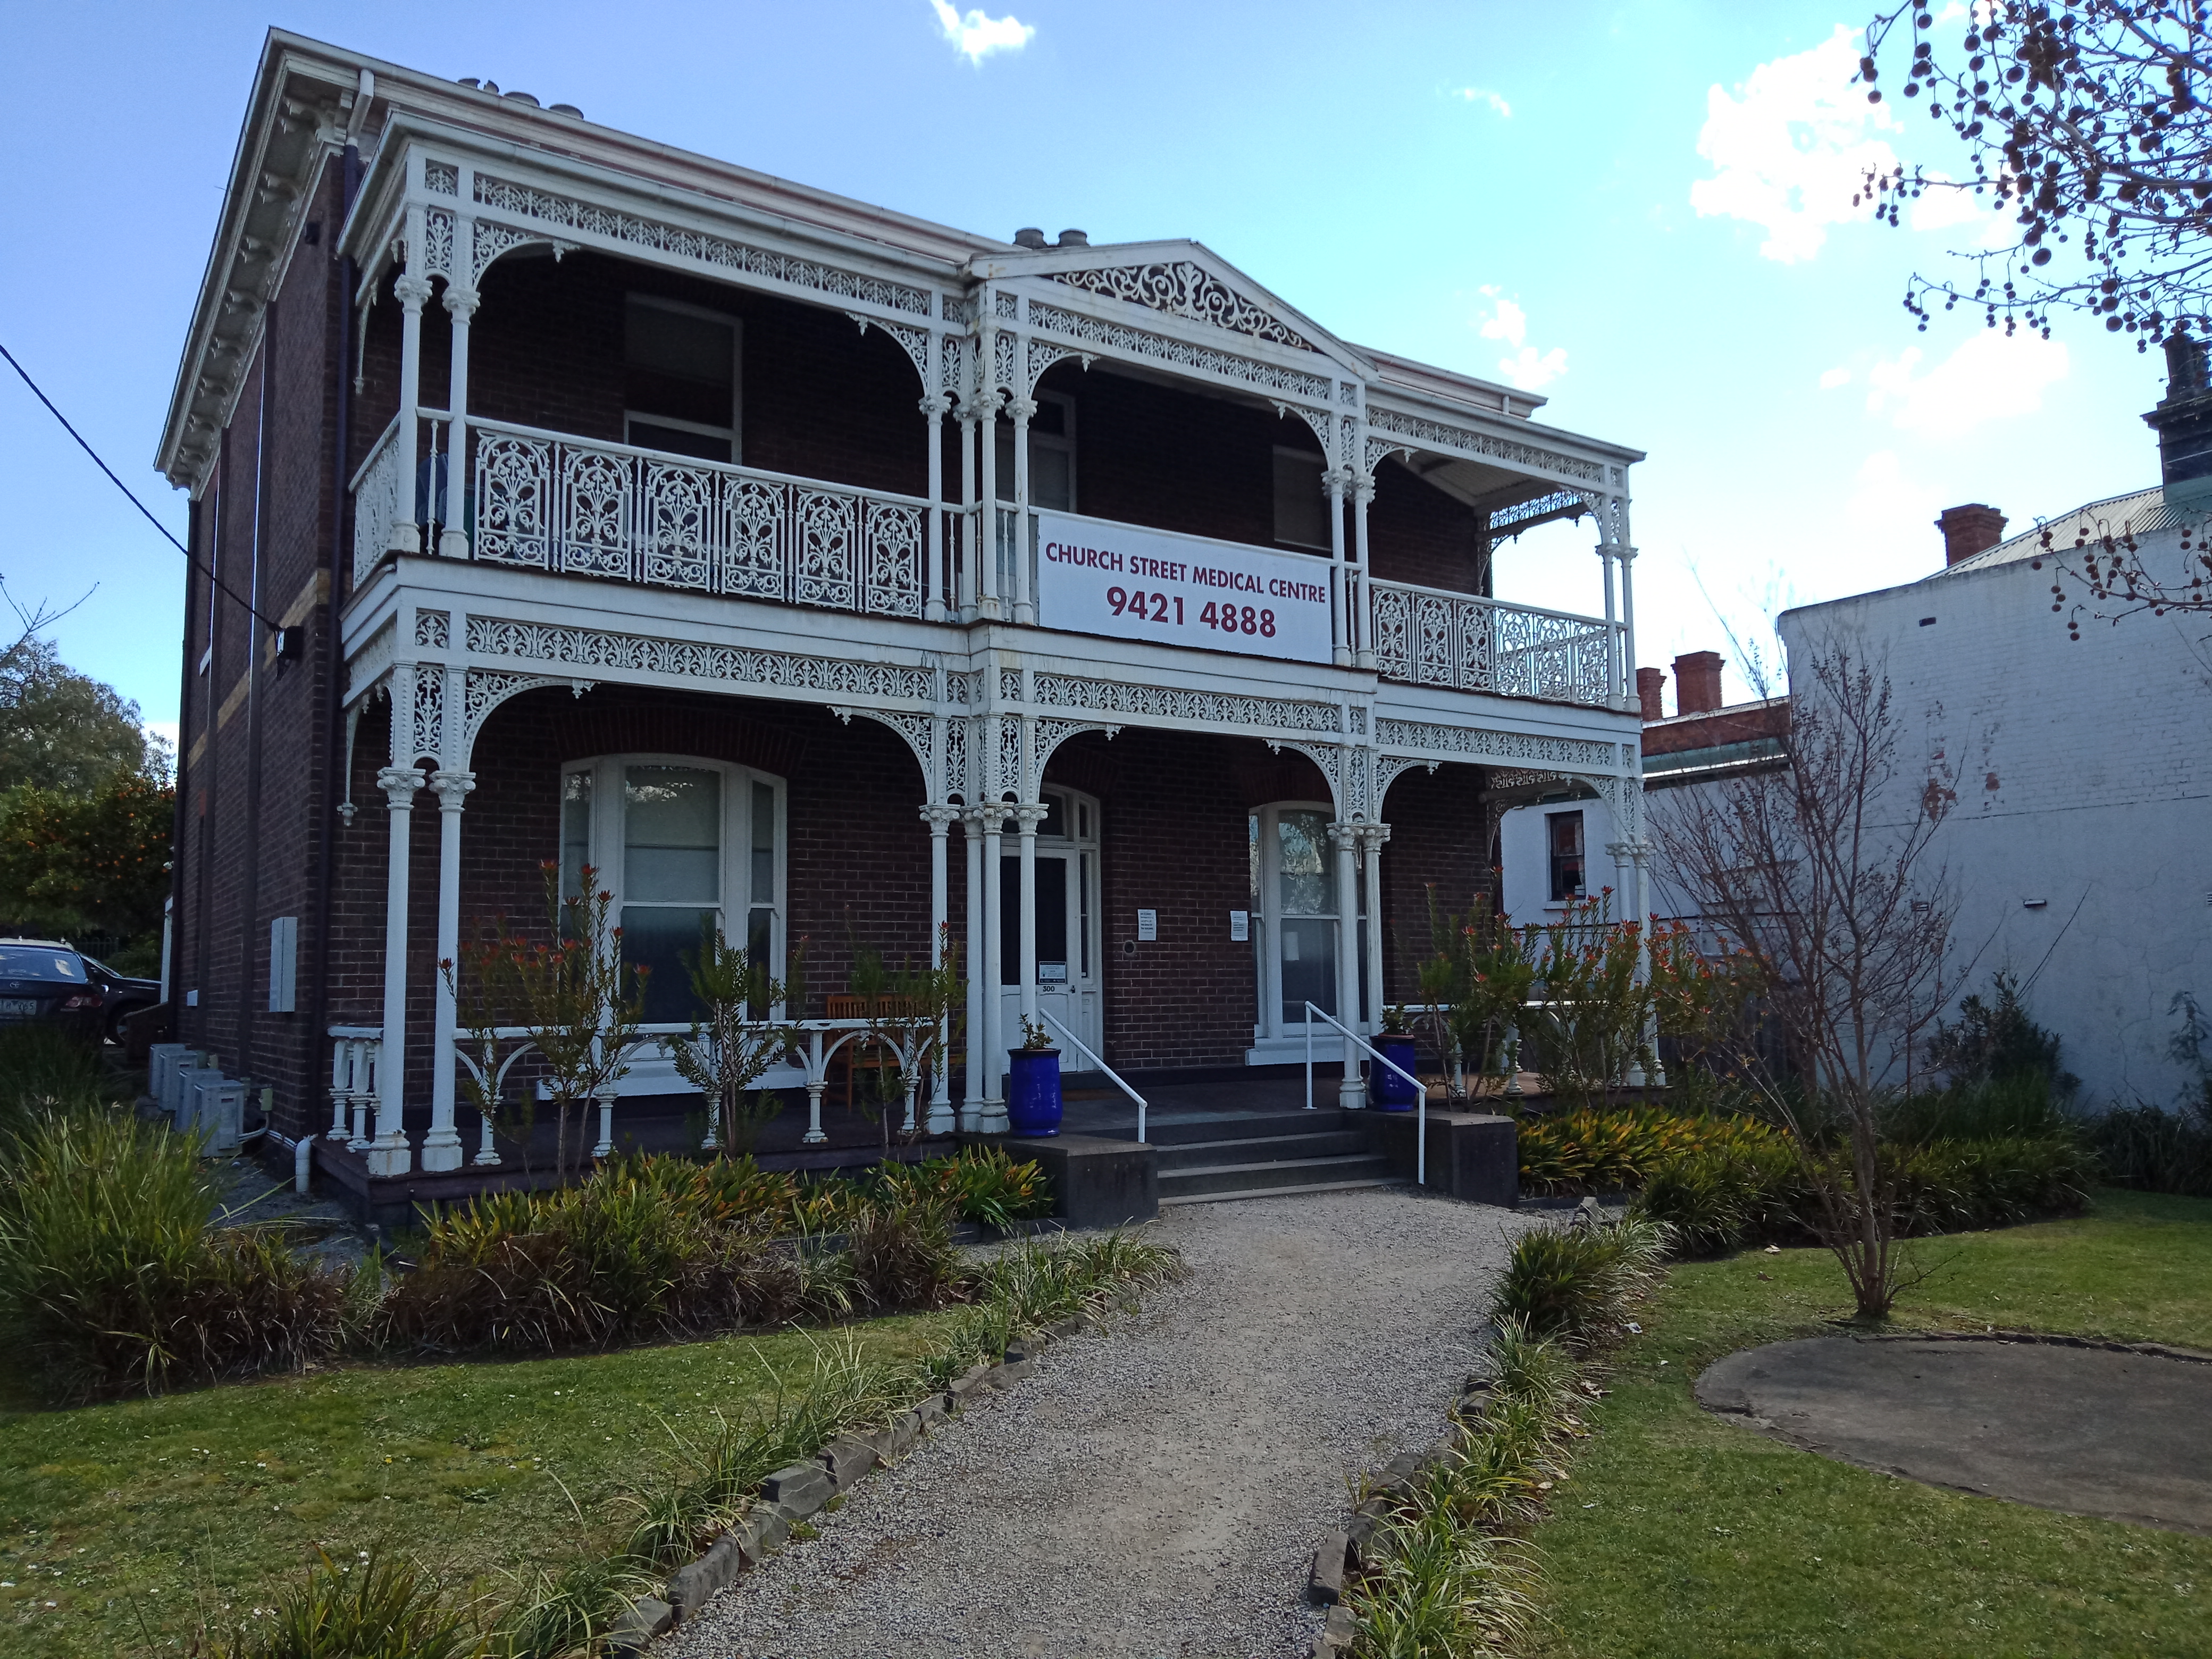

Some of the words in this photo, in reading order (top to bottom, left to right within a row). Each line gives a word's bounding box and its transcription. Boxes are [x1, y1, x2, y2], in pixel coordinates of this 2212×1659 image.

[1045, 542, 1123, 573] CHURCH
[1129, 555, 1187, 582] STREET
[1192, 566, 1264, 594] MEDICAL
[1269, 578, 1326, 604] CENTRE
[1107, 586, 1184, 626] 9421
[1200, 601, 1276, 638] 4888
